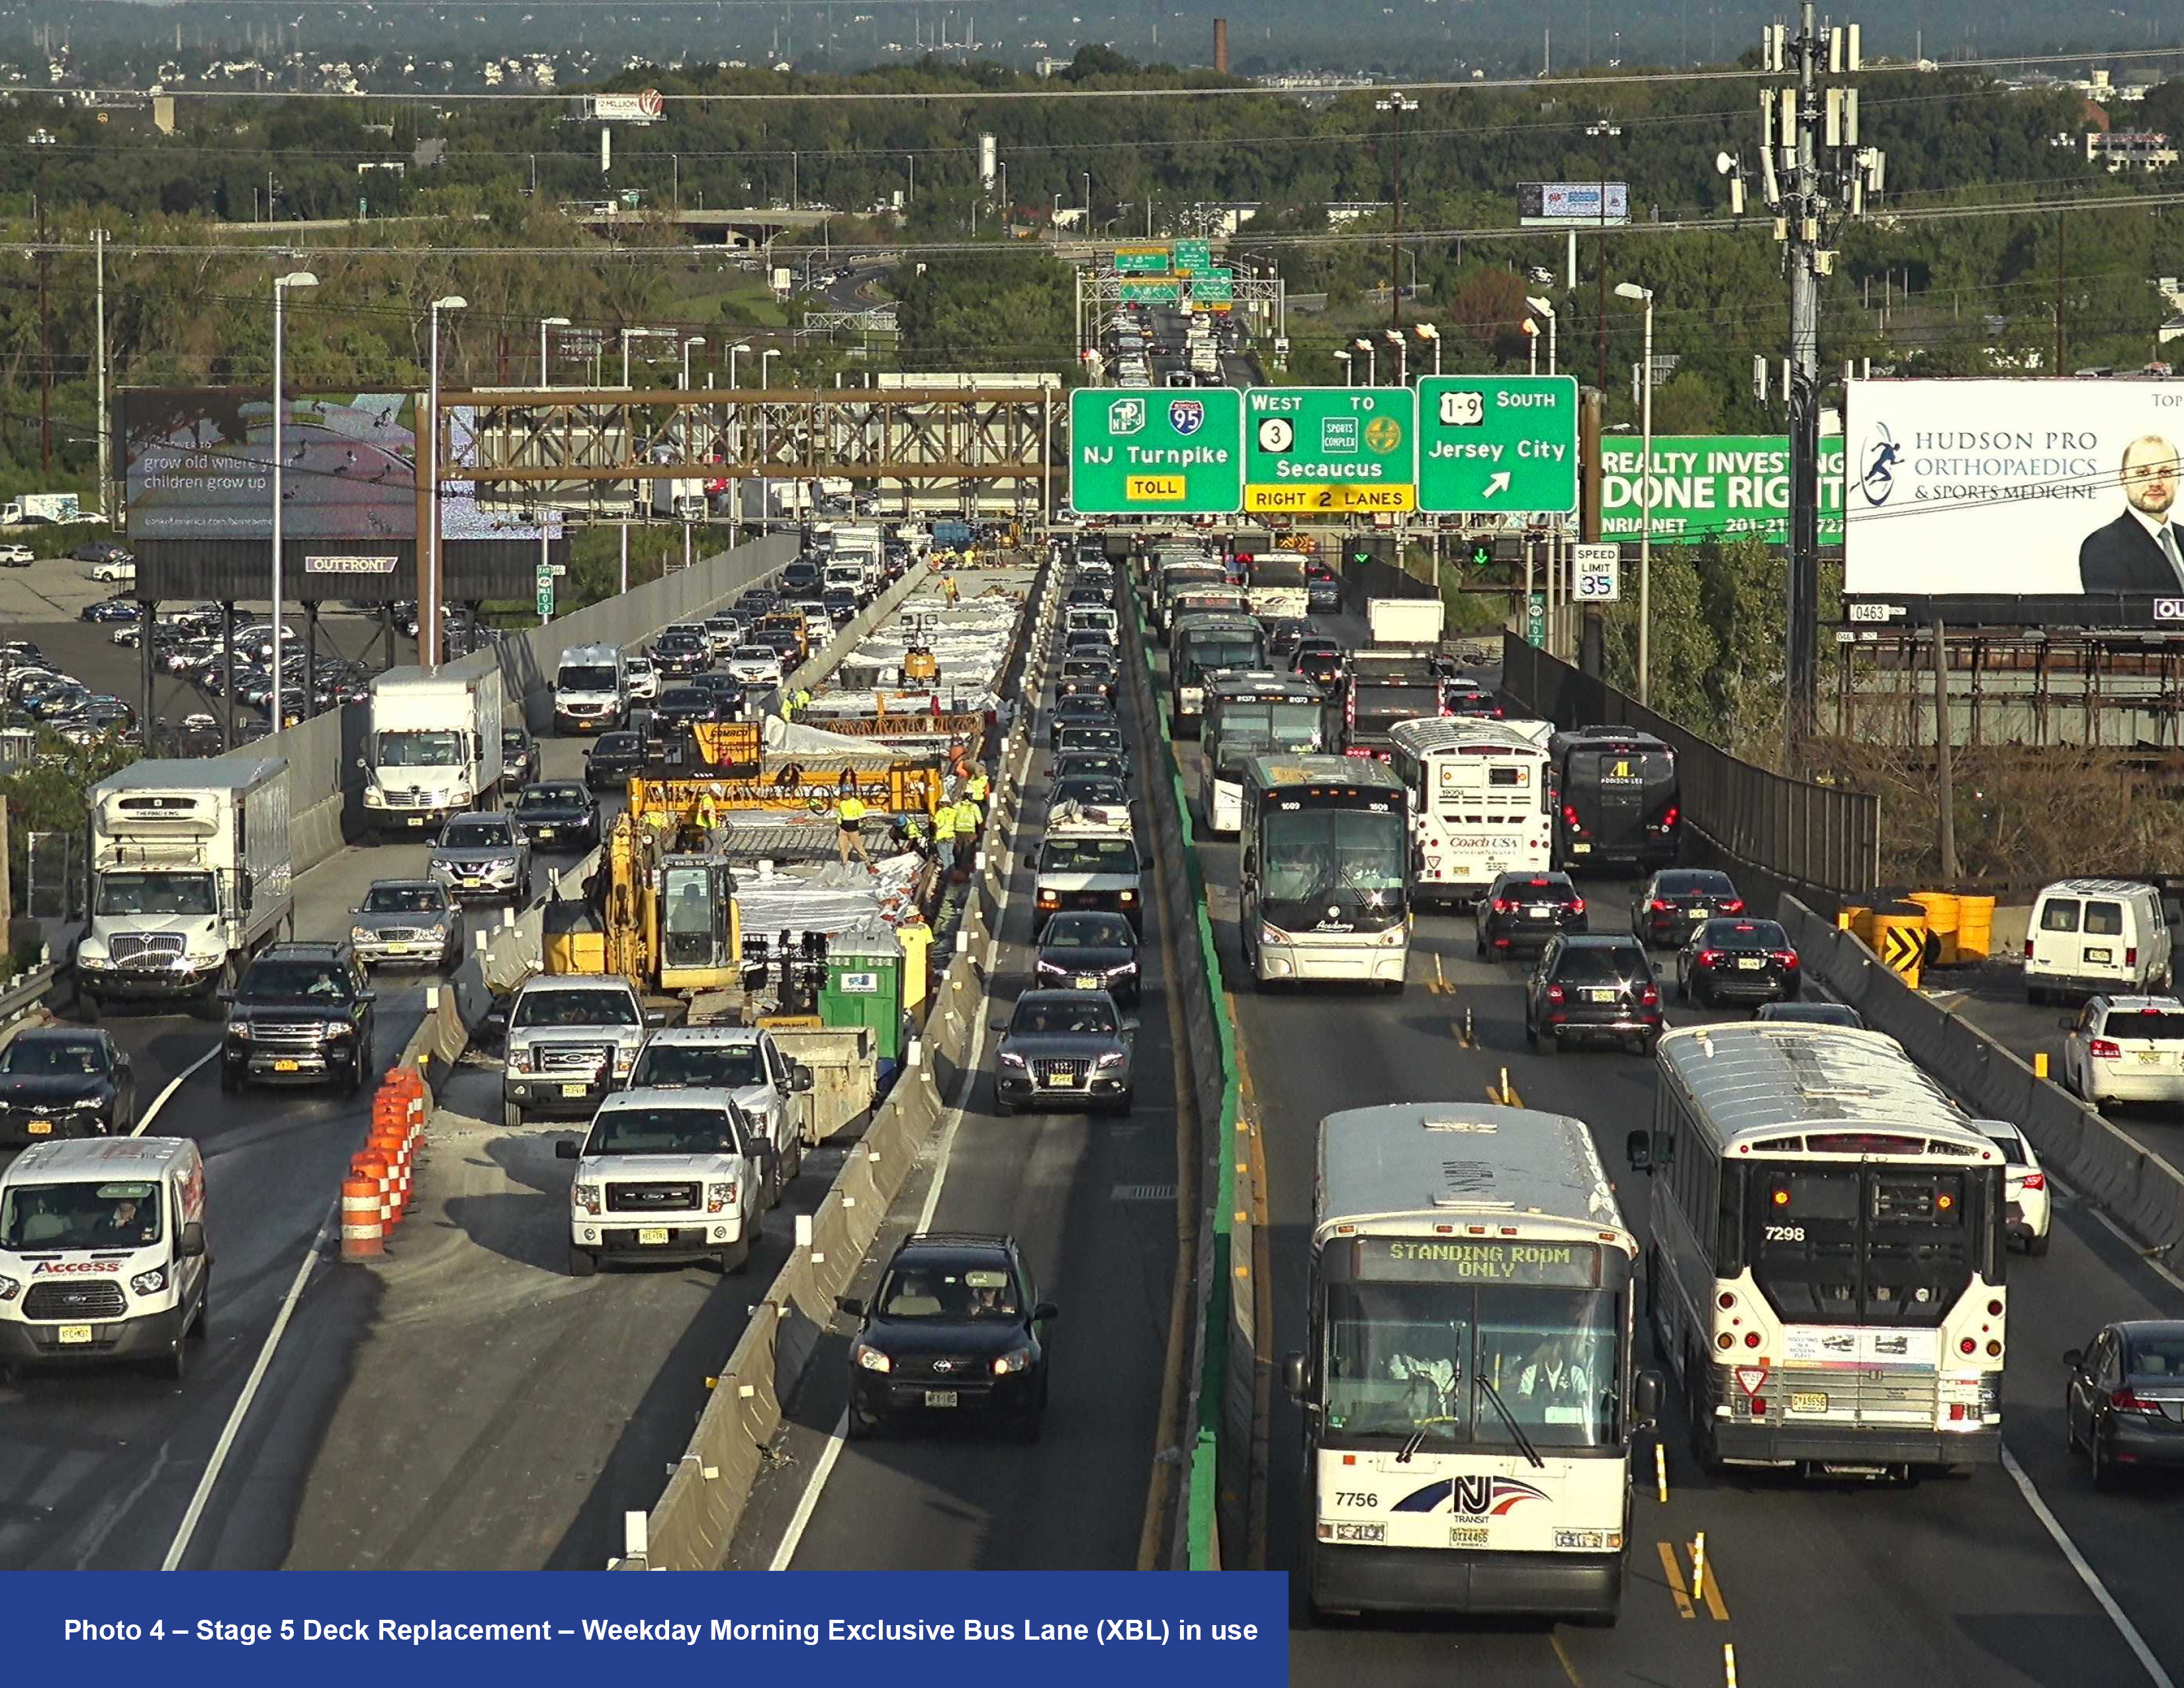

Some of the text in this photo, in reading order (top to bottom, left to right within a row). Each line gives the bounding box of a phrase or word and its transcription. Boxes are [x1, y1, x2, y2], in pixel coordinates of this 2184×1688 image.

[1251, 394, 1375, 411] WEST TO
[1447, 391, 1556, 417] 1-9 SOUTH
[1174, 410, 1199, 430] 95
[1326, 423, 1353, 434] SPORTS
[1270, 426, 1281, 444] 3
[1324, 437, 1355, 447] COMPLEX
[1916, 432, 2097, 450] HUDSON PRO
[1083, 445, 1228, 468] NJ Turnpike
[1428, 439, 1566, 462] Jersey City
[144, 457, 183, 473] grow
[185, 455, 208, 469] old
[211, 455, 257, 469] where
[1276, 459, 1383, 477] Secaucus
[1602, 451, 1699, 474] REALTY
[1914, 457, 2097, 476] ORTHOPAEDICS
[144, 475, 265, 492] children grow up
[1134, 481, 1177, 494] TOLL
[1602, 476, 1844, 508] DONE RIGT
[1256, 491, 1403, 507] RIGHT 2 LANES
[1915, 485, 2097, 500] & SPORTS MEDICINE
[1578, 549, 1615, 559] SPEED
[314, 559, 387, 571] OUTFRONT
[1581, 563, 1611, 573] LIMIT
[1581, 575, 1611, 594] 35
[1856, 606, 1884, 620] 0463
[1449, 837, 1518, 848] Coach USA
[1765, 1226, 1805, 1242] 7298
[1390, 1243, 1502, 1262] STANDING
[32, 1262, 120, 1274] Access
[1458, 1261, 1515, 1278] ONLY
[1335, 1491, 1379, 1507] 7756
[1453, 1476, 1491, 1515] NJ
[1453, 1515, 1490, 1524] TRANSIT
